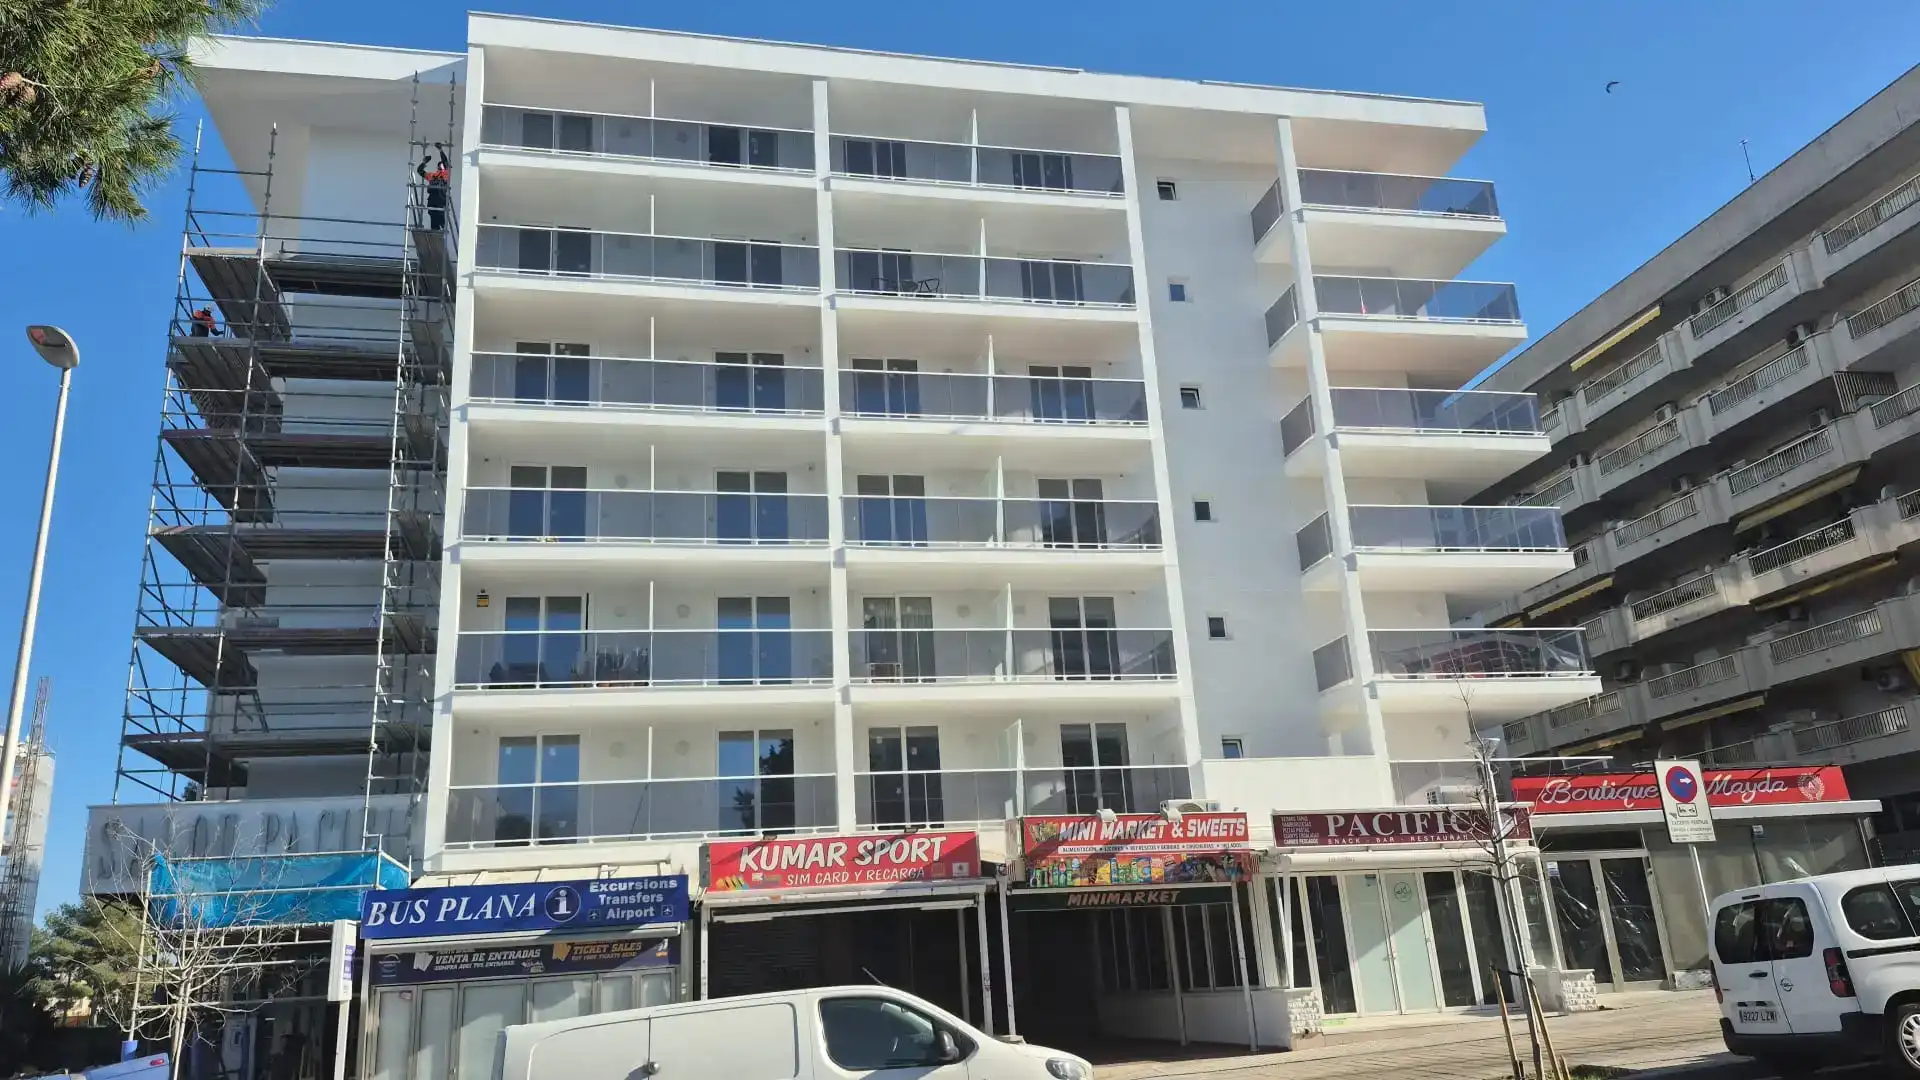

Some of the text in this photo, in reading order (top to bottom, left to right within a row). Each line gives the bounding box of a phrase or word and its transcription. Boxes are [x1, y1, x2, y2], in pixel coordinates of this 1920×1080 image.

[1542, 773, 1788, 808] Boutique Mayda
[1058, 818, 1246, 842] MINI MARKET & SWEETS
[1326, 811, 1473, 837] PACIFIC
[739, 836, 947, 872] KUMAR SPORT
[589, 878, 677, 892] Excursions
[787, 874, 810, 886] SIM
[815, 872, 848, 885] CARD
[854, 871, 861, 882] Y
[867, 867, 925, 881] RECARGA
[600, 892, 663, 905] Transfers
[1067, 890, 1181, 907] MINIMARKET
[366, 898, 429, 926] BUS
[436, 892, 537, 922] PLANA
[606, 906, 655, 921] Airport
[435, 954, 468, 965] VENTA
[472, 953, 484, 963] DE
[487, 949, 541, 962] ENTRADAS
[574, 942, 642, 955] TICKET SALES
